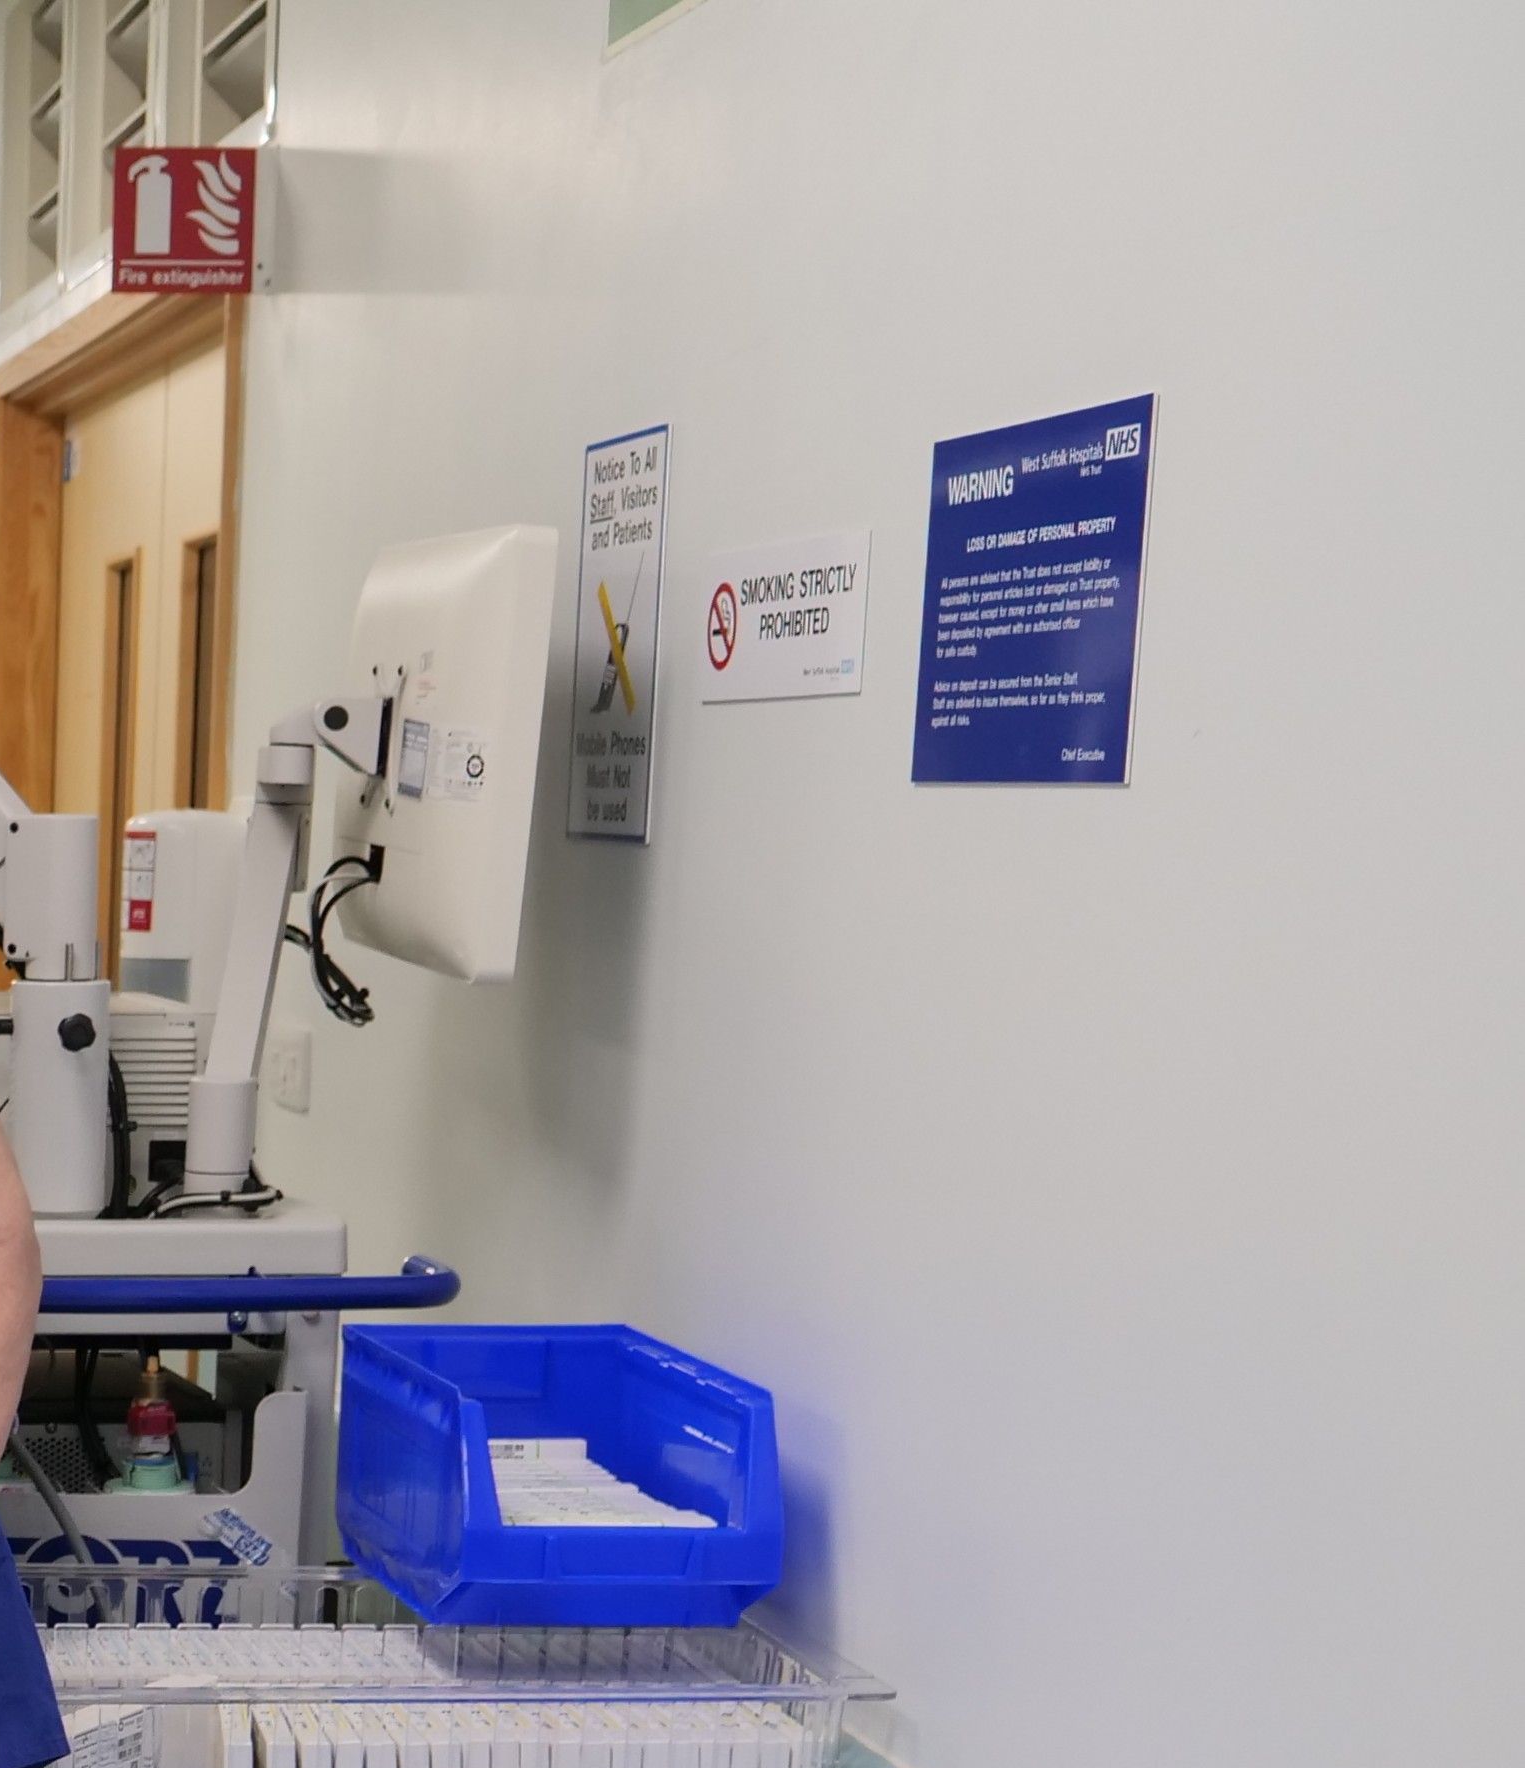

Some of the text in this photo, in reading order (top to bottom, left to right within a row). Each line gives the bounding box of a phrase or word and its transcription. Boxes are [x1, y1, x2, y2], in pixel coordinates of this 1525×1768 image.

[118, 264, 246, 289] Fire extinguisher
[594, 446, 659, 485] Notice To All
[1021, 426, 1139, 475] West Suffolk Hospitals NHS
[620, 484, 658, 512] Visitors
[947, 464, 1014, 507] WARNING
[591, 516, 653, 552] and Patients
[966, 514, 1118, 554] LOSS OR DAMAGE OF PERSONAL PROPERTY
[740, 562, 857, 607] SMOKING STRICTLY
[759, 606, 830, 641] PROHIBITED
[575, 730, 646, 757] Mobile Phones
[1061, 747, 1077, 761] Chief
[585, 764, 631, 790] Must Not
[586, 796, 628, 822] be used
